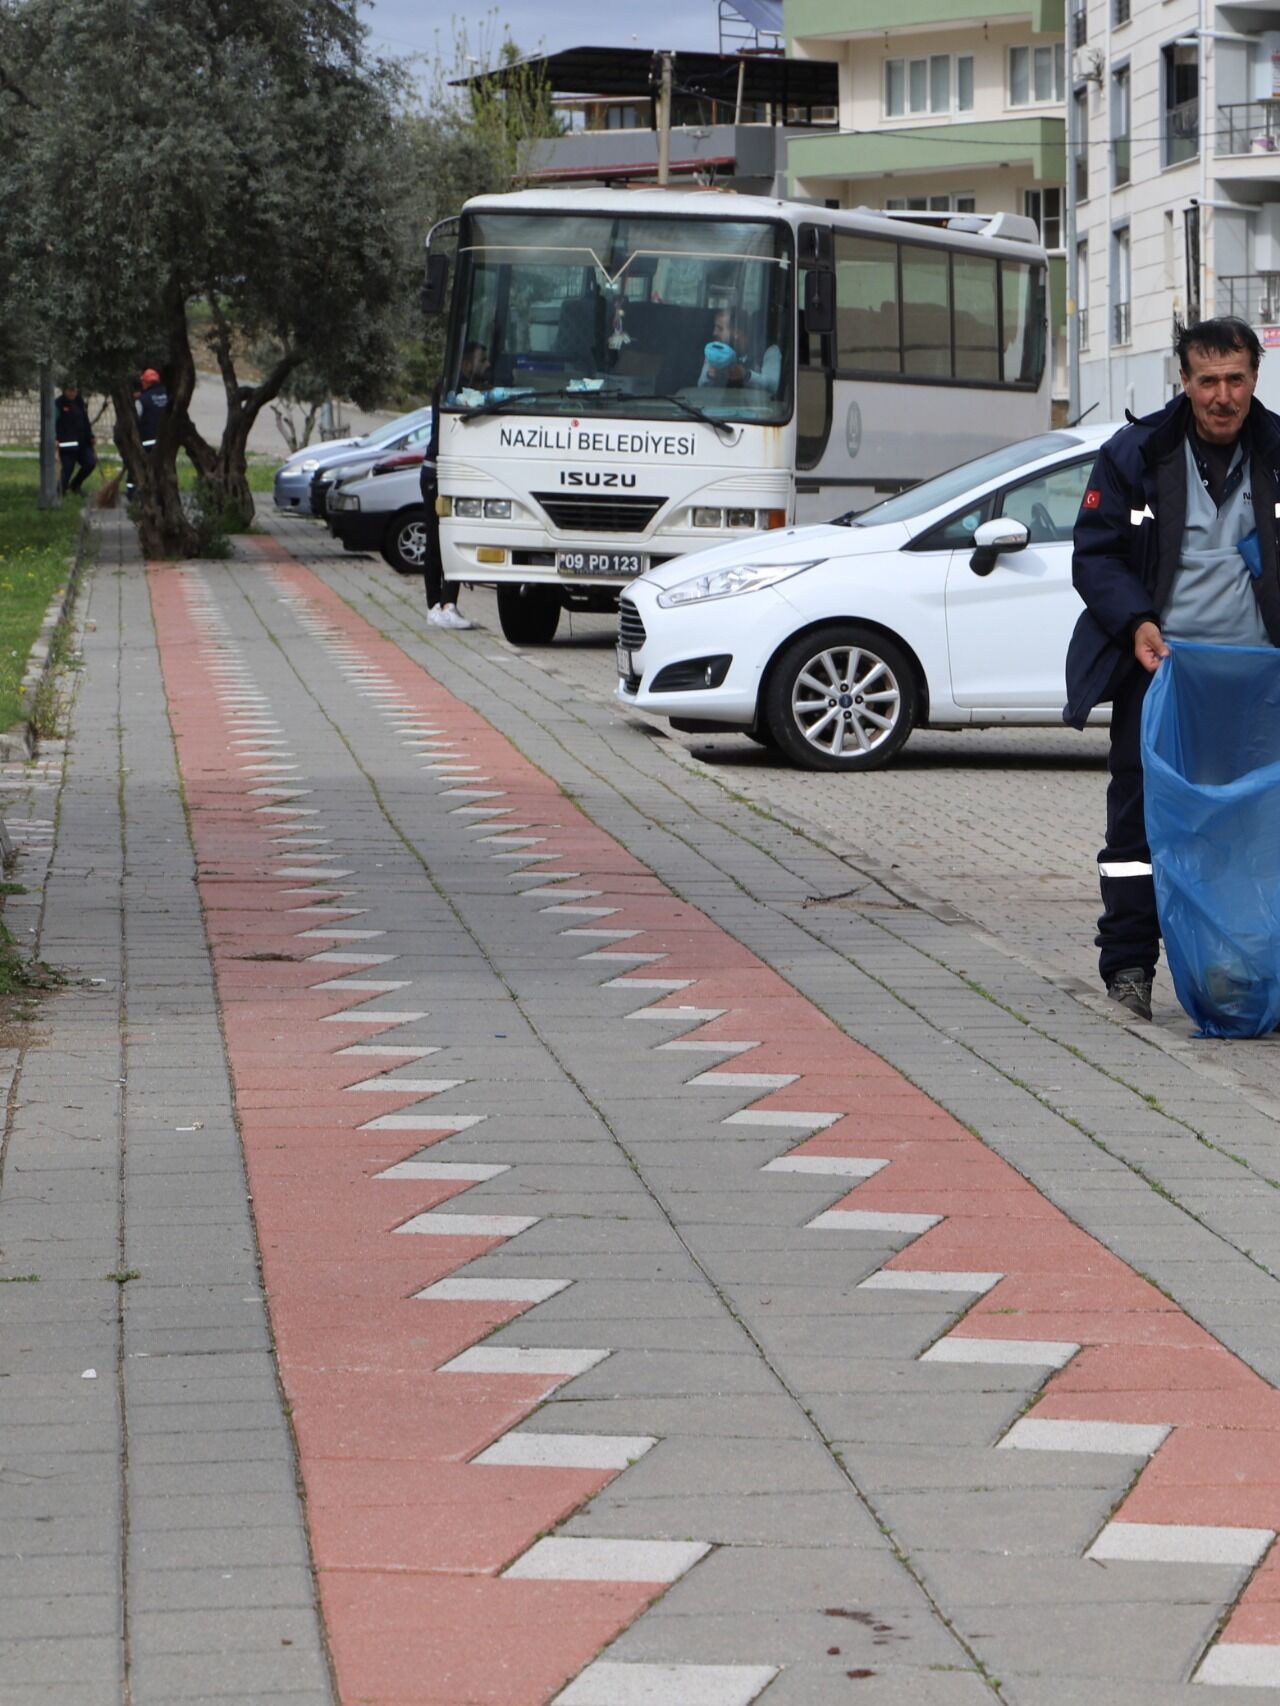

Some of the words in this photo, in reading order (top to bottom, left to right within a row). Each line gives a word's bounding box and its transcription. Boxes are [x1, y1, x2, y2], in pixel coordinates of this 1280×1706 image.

[500, 426, 572, 449] NAZİLLİ
[578, 431, 696, 456] BELEDİYESİ
[560, 471, 637, 488] ISUZU
[565, 553, 584, 569] 09
[589, 555, 610, 570] PD
[613, 556, 639, 571] 123
